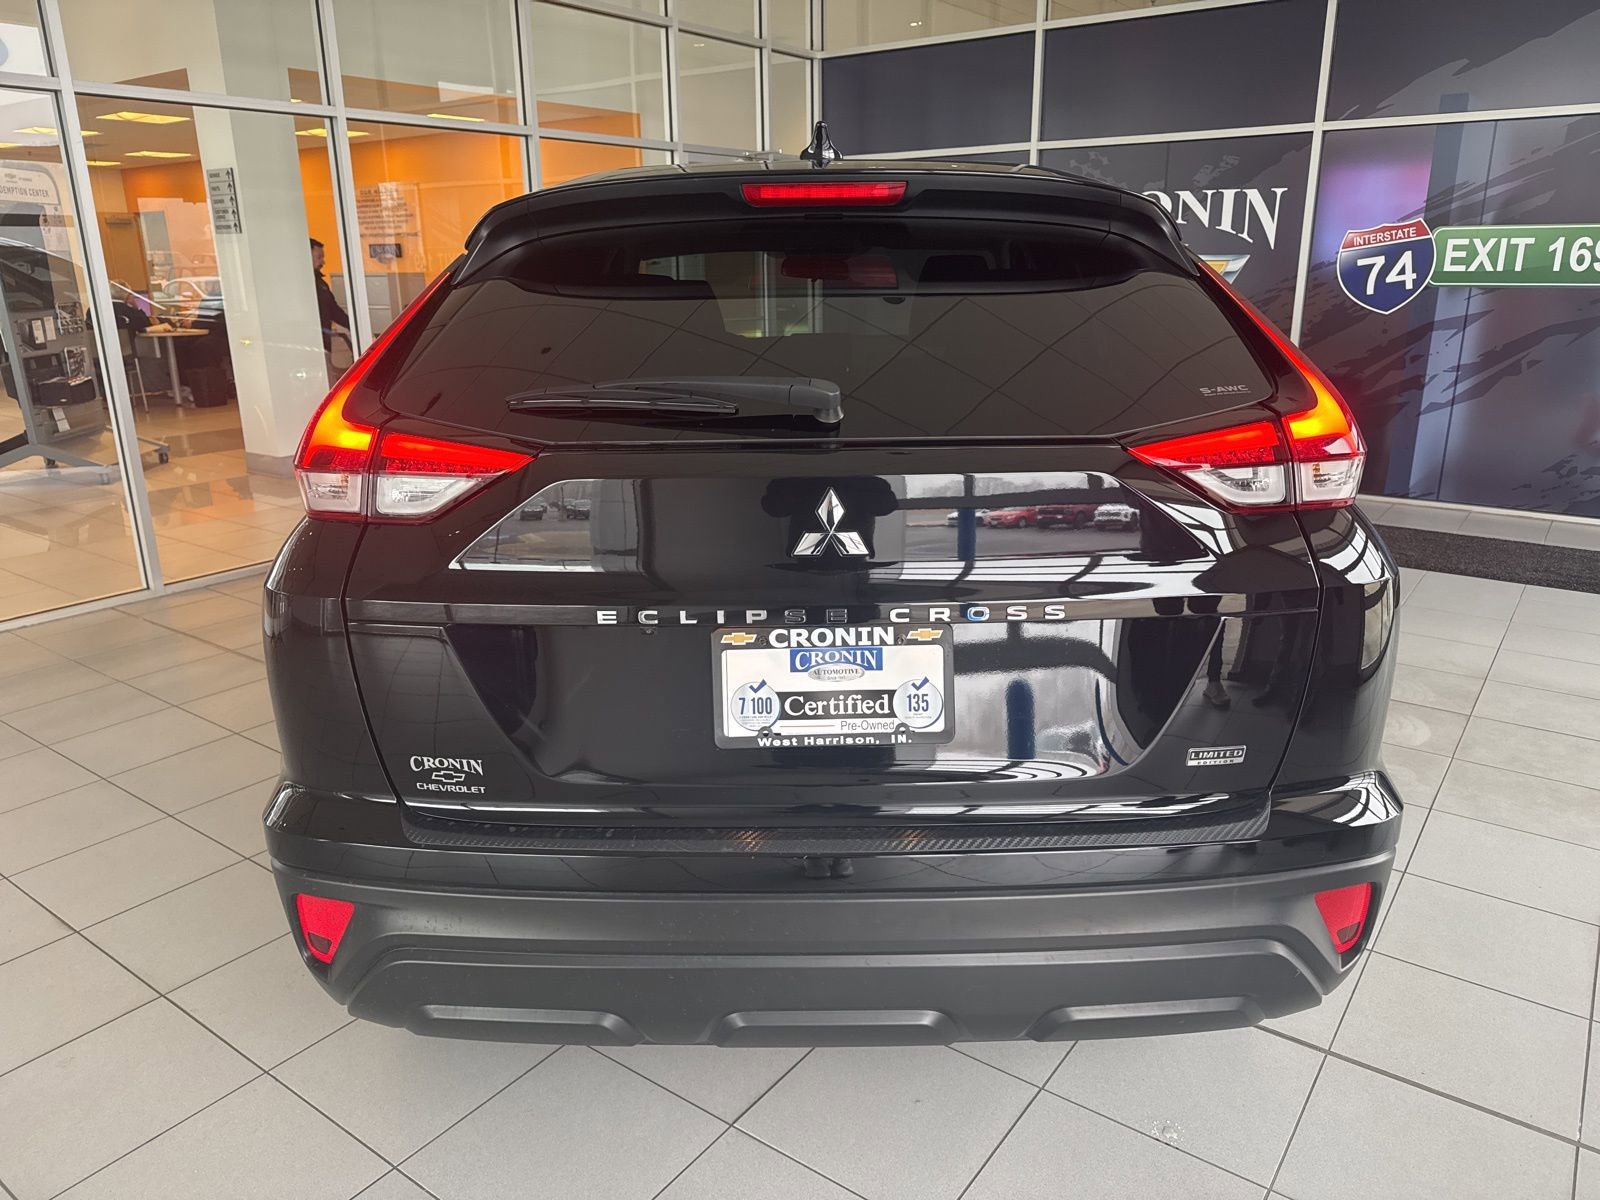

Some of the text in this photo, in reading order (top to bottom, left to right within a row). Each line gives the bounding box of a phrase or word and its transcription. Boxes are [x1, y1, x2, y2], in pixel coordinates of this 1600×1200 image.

[1353, 227, 1417, 246] INTERSTATE
[1443, 237, 1536, 272] EXIT
[1356, 250, 1417, 295] 74
[1199, 384, 1249, 394] S-AWC
[596, 605, 1066, 624] ECLIPSE CROSS
[768, 627, 895, 648] CRONIN
[795, 650, 878, 670] CRONIN
[813, 668, 859, 676] AUTOMOTIVE
[784, 693, 891, 716] Certified
[906, 693, 930, 712] 135
[840, 720, 895, 731] Pre-Owned
[757, 734, 913, 747] West Harrison, IN.
[1191, 750, 1242, 759] LIMITED
[410, 755, 484, 776] CRONIN
[416, 783, 485, 793] CHEVROLET
